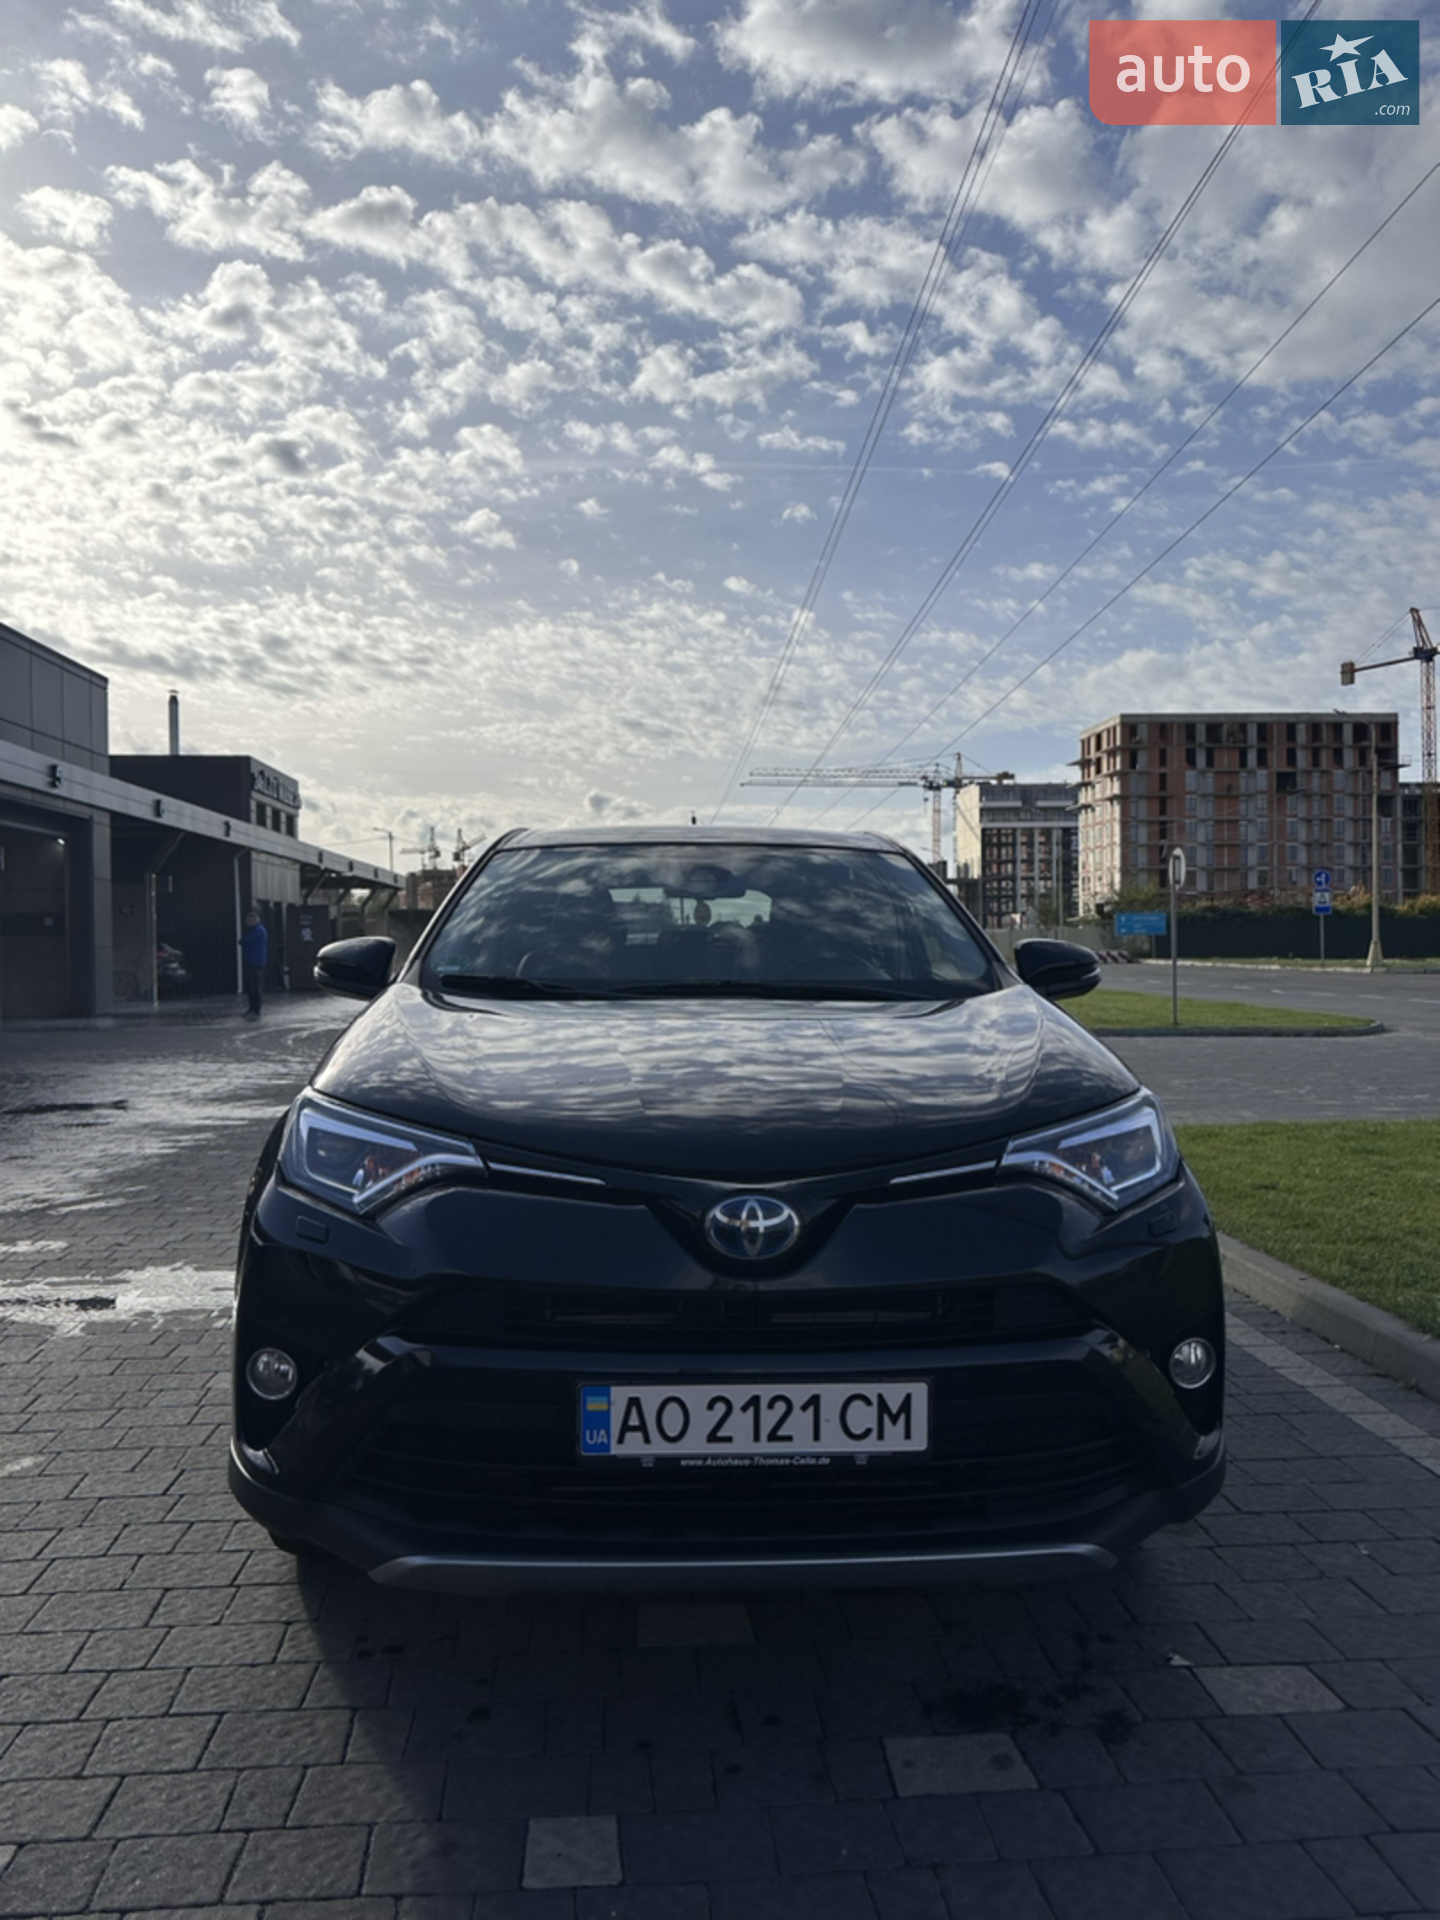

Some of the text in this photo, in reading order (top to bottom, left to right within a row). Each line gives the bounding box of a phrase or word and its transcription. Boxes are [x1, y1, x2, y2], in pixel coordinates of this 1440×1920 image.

[616, 1391, 913, 1445] AO 2121 CM
[585, 1429, 609, 1445] UA
